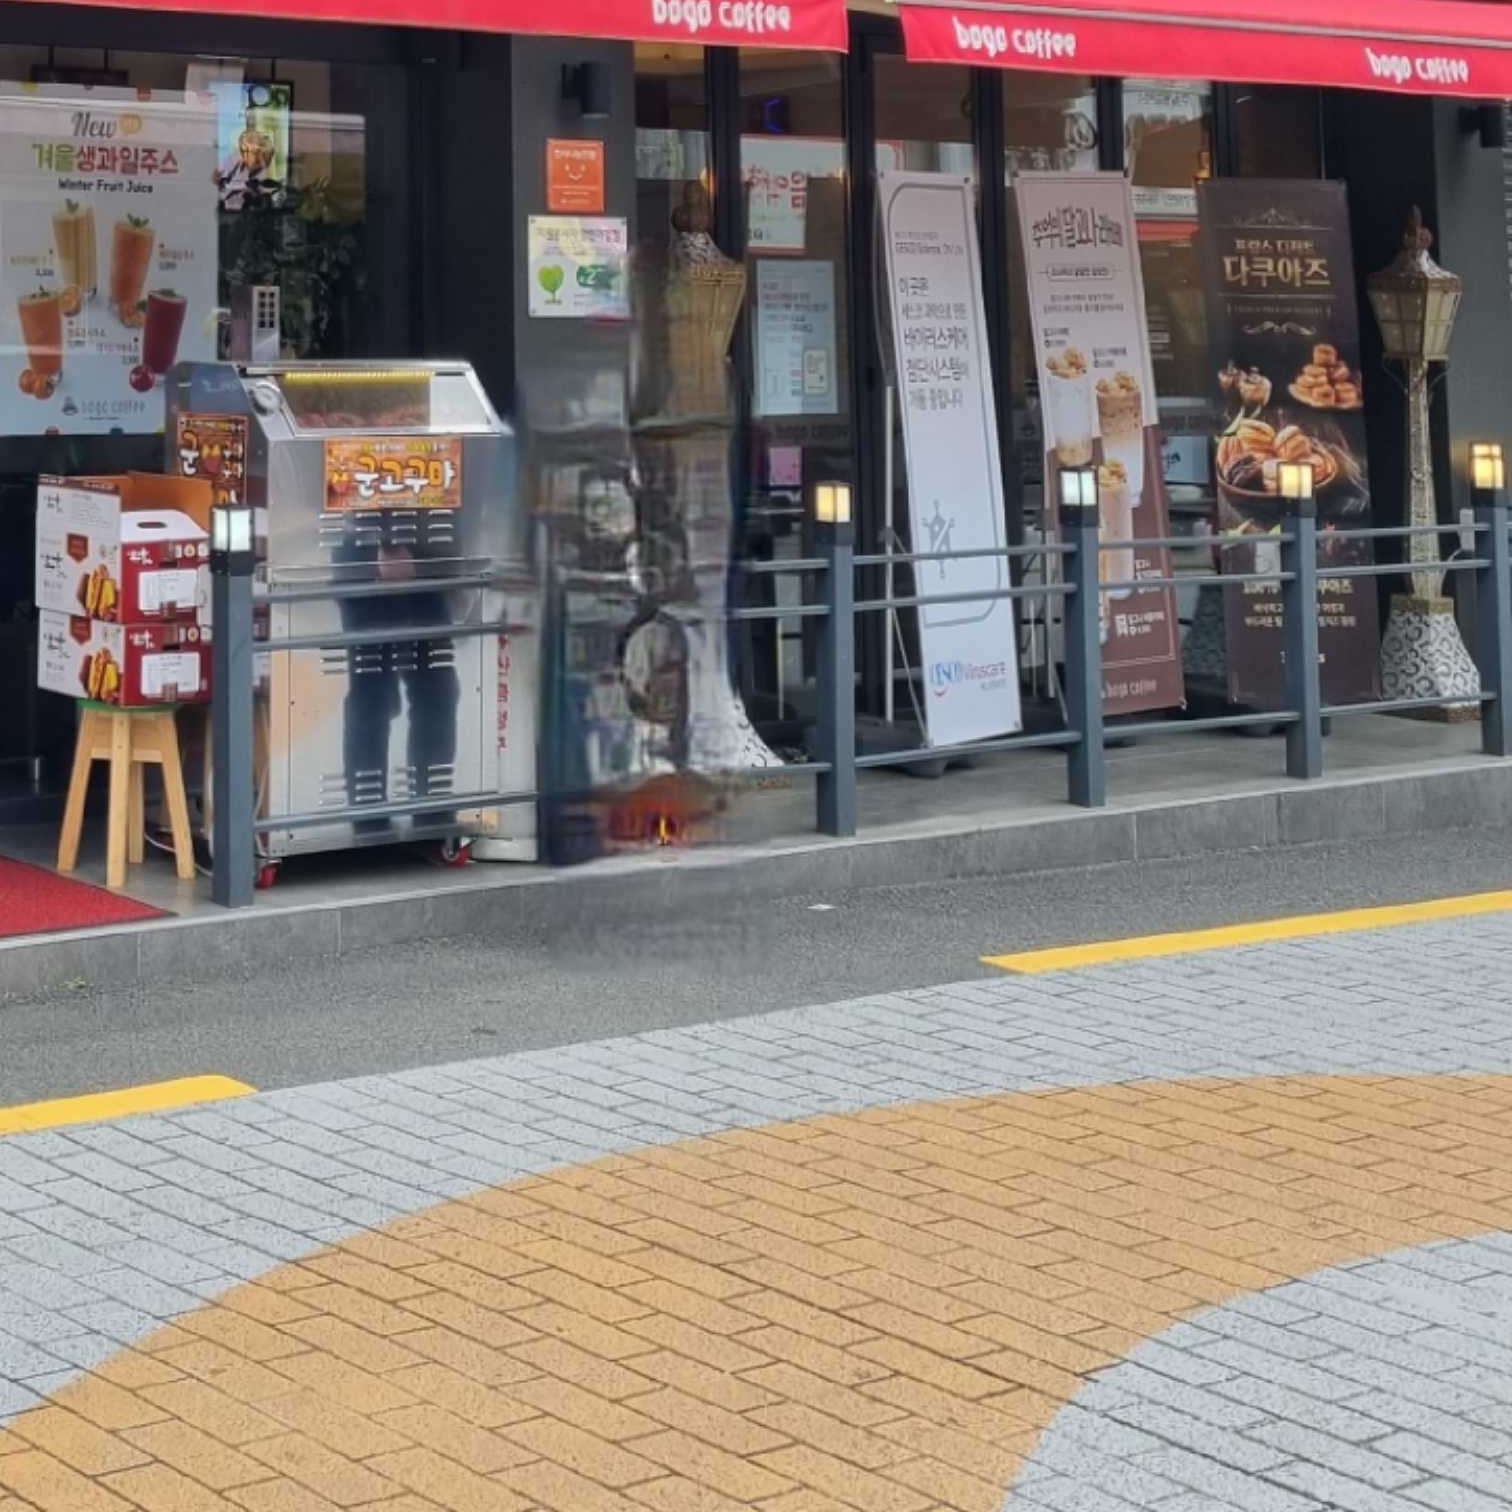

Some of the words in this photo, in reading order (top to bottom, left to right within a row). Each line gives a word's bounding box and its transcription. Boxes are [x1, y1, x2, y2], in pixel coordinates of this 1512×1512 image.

[718, 0, 792, 34] coffee
[952, 16, 1007, 58] bogo
[1011, 28, 1077, 59] coffee
[70, 112, 118, 138] New
[57, 178, 94, 192] Winter
[126, 182, 154, 194] Juice
[1223, 254, 1331, 288] 다쿠아즈
